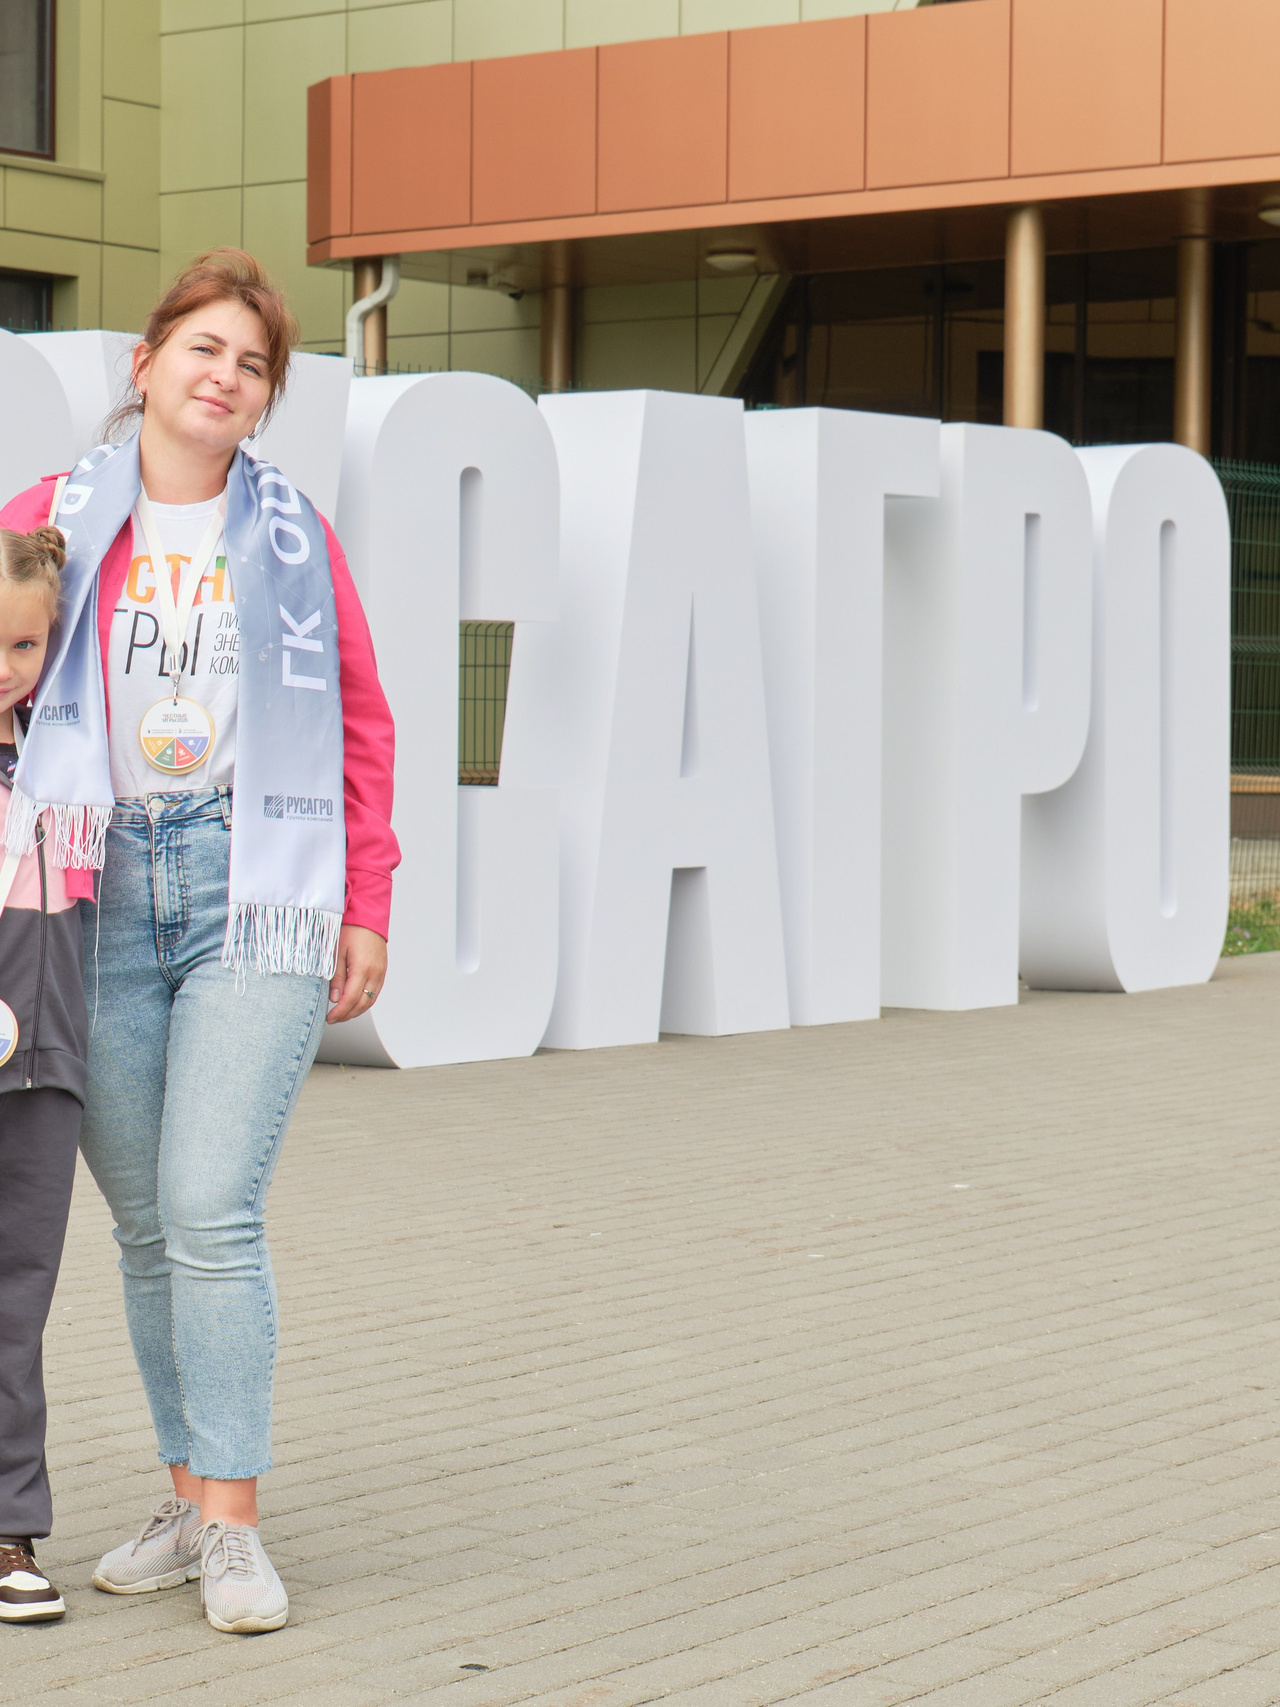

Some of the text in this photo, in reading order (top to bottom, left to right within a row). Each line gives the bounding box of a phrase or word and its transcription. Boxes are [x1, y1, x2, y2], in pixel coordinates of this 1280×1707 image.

[126, 553, 235, 607] СТН
[114, 608, 204, 677] РЫ
[218, 611, 240, 631] ЛИ
[279, 603, 327, 691] ГК
[286, 796, 333, 816] РУСАГРО
